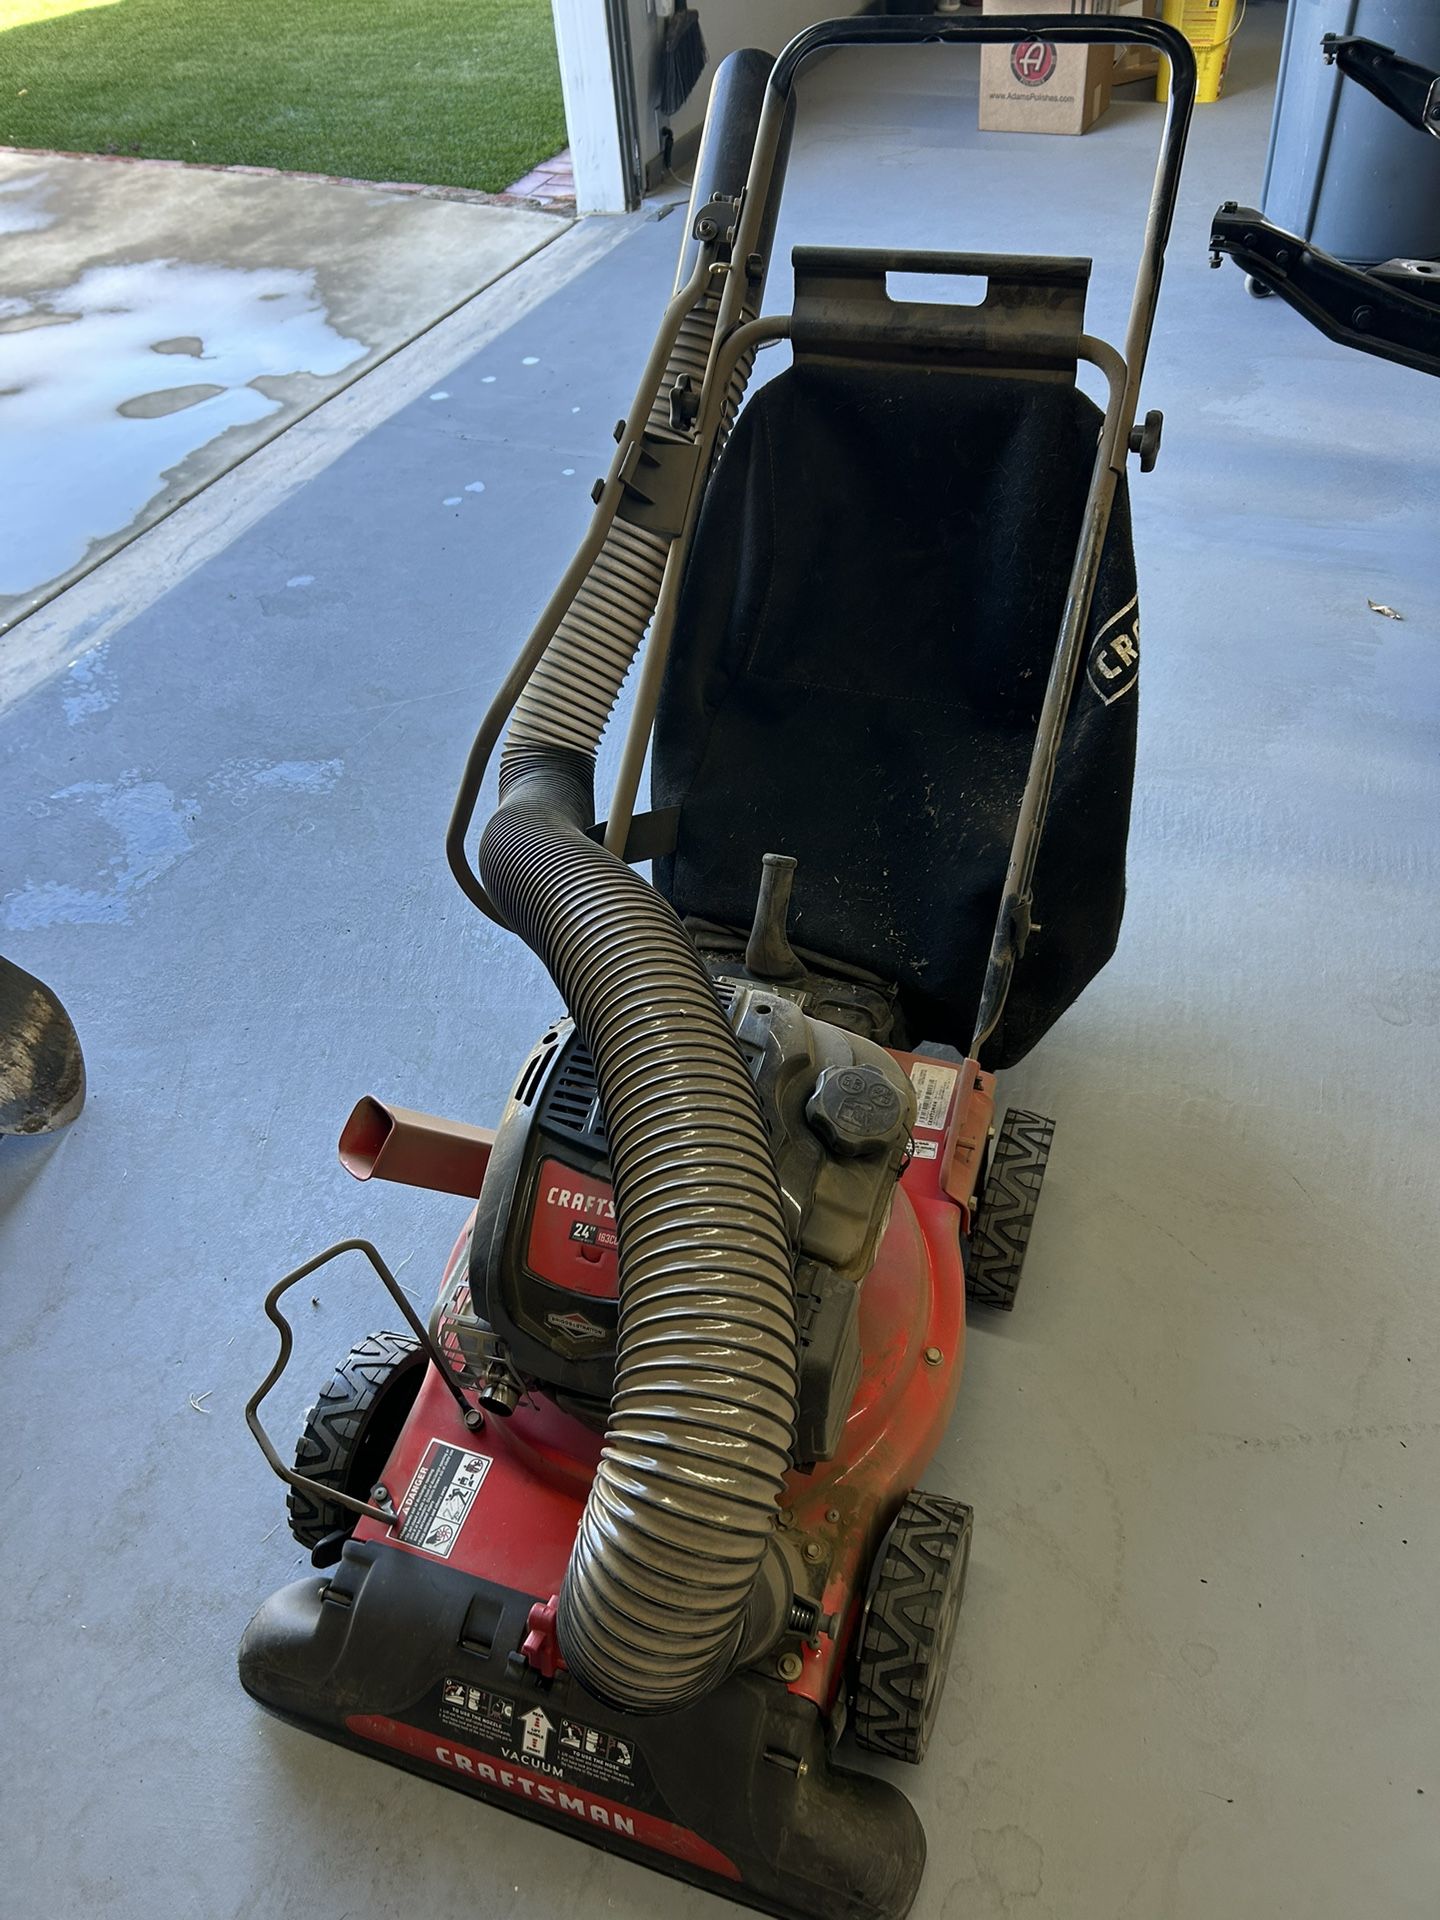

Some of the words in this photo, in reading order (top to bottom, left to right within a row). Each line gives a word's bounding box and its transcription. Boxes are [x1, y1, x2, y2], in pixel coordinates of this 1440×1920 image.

[989, 91, 1075, 104] www.AdamsPolishes.com
[573, 1222, 597, 1239] 24"
[404, 1466, 429, 1505] DANGER
[482, 1717, 501, 1729] NOZZLE
[501, 1747, 564, 1778] VACUUM
[604, 1762, 618, 1770] HOSE
[436, 1747, 635, 1836] CRAFTSMAN
